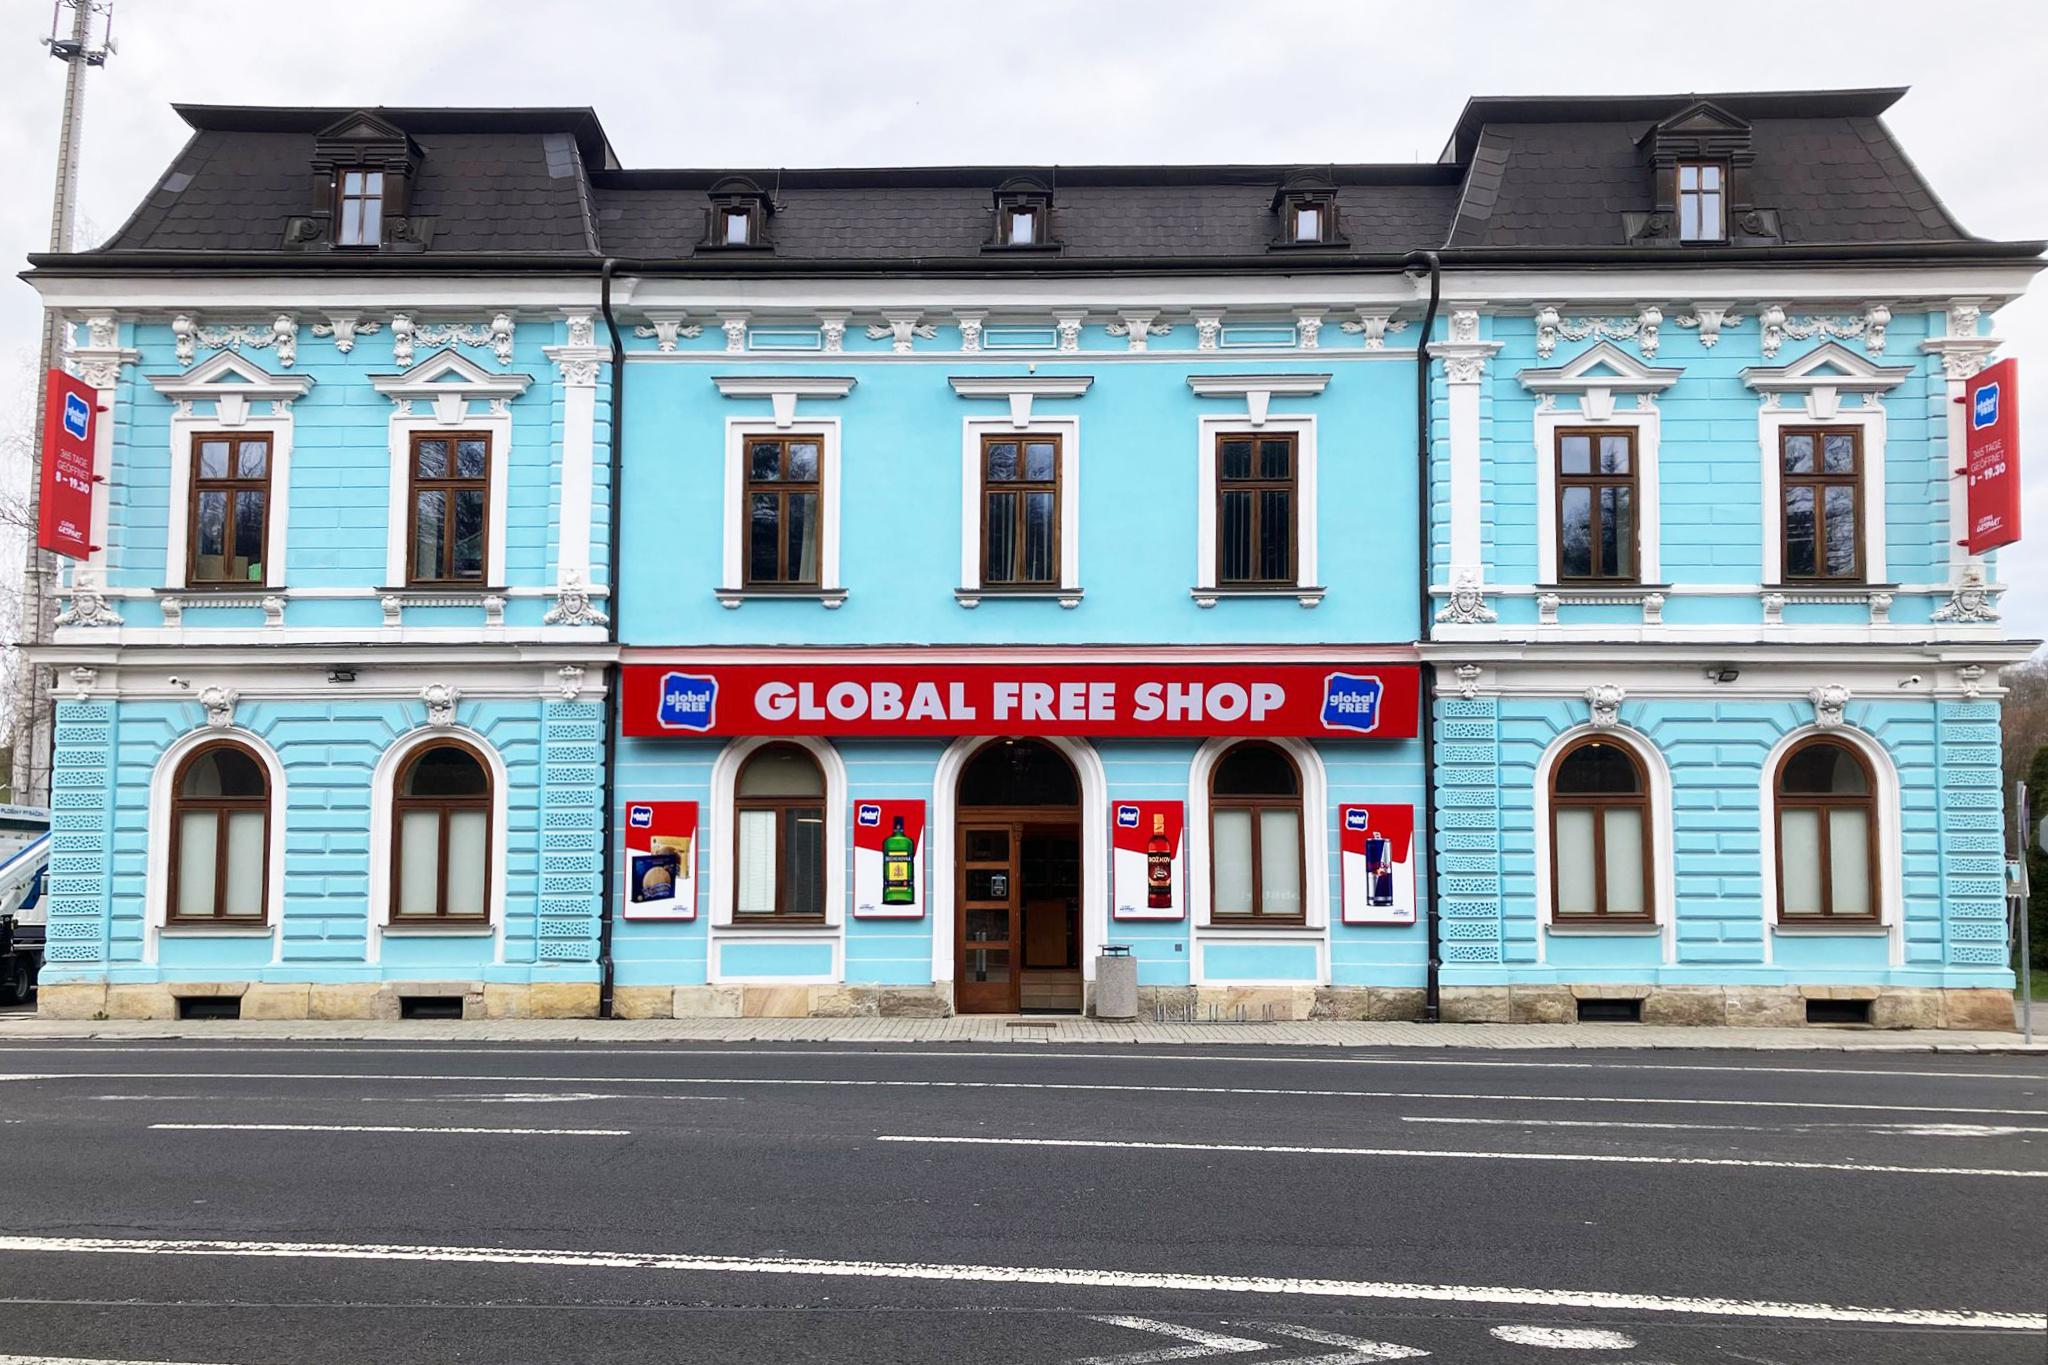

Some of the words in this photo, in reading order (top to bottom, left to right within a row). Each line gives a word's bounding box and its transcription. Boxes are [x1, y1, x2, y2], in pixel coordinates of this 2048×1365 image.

[1985, 438, 2002, 454] TAGE
[72, 453, 88, 469] TAGE
[55, 470, 62, 482] 8
[69, 477, 90, 494] 19.30
[1970, 475, 1976, 487] 8
[1984, 462, 2006, 480] 19.30
[666, 690, 710, 706] global
[753, 681, 977, 722] GLOBAL
[993, 682, 1117, 721] FREE
[1132, 682, 1286, 722] SHOP
[1329, 691, 1375, 707] global
[674, 701, 706, 713] FREE
[1338, 702, 1370, 713] FREE
